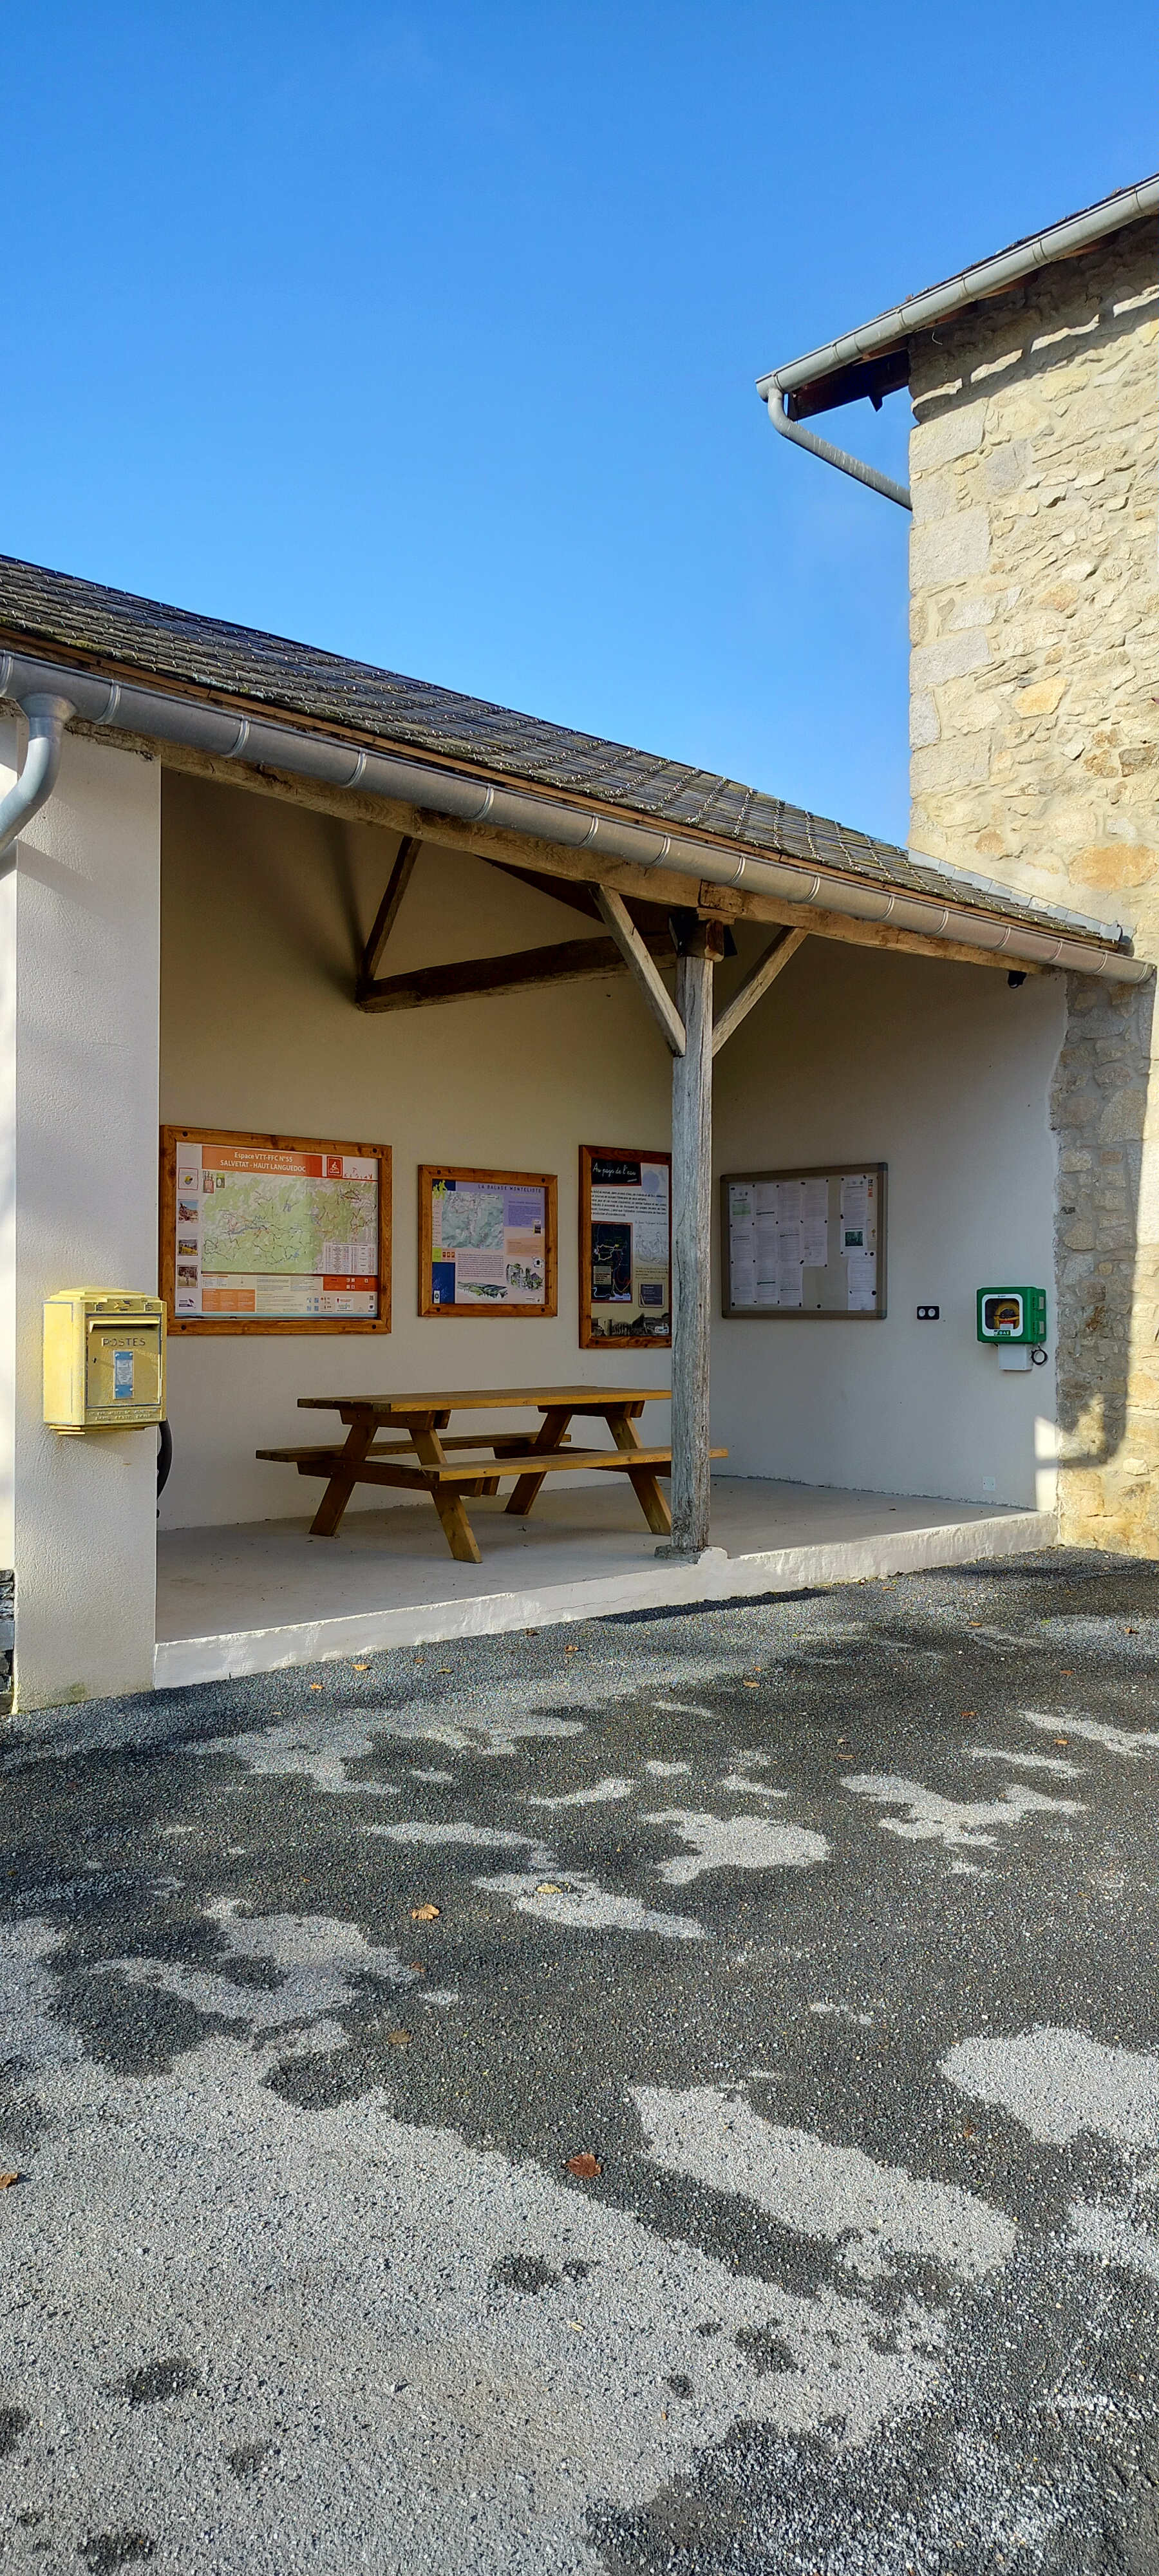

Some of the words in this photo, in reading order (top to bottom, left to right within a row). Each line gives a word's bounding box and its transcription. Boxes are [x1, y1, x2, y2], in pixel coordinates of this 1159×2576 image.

[270, 1164, 306, 1172] LANGUEDOC
[592, 1162, 601, 1173] Au
[602, 1169, 614, 1178] pays
[101, 1338, 146, 1347] POSTES
